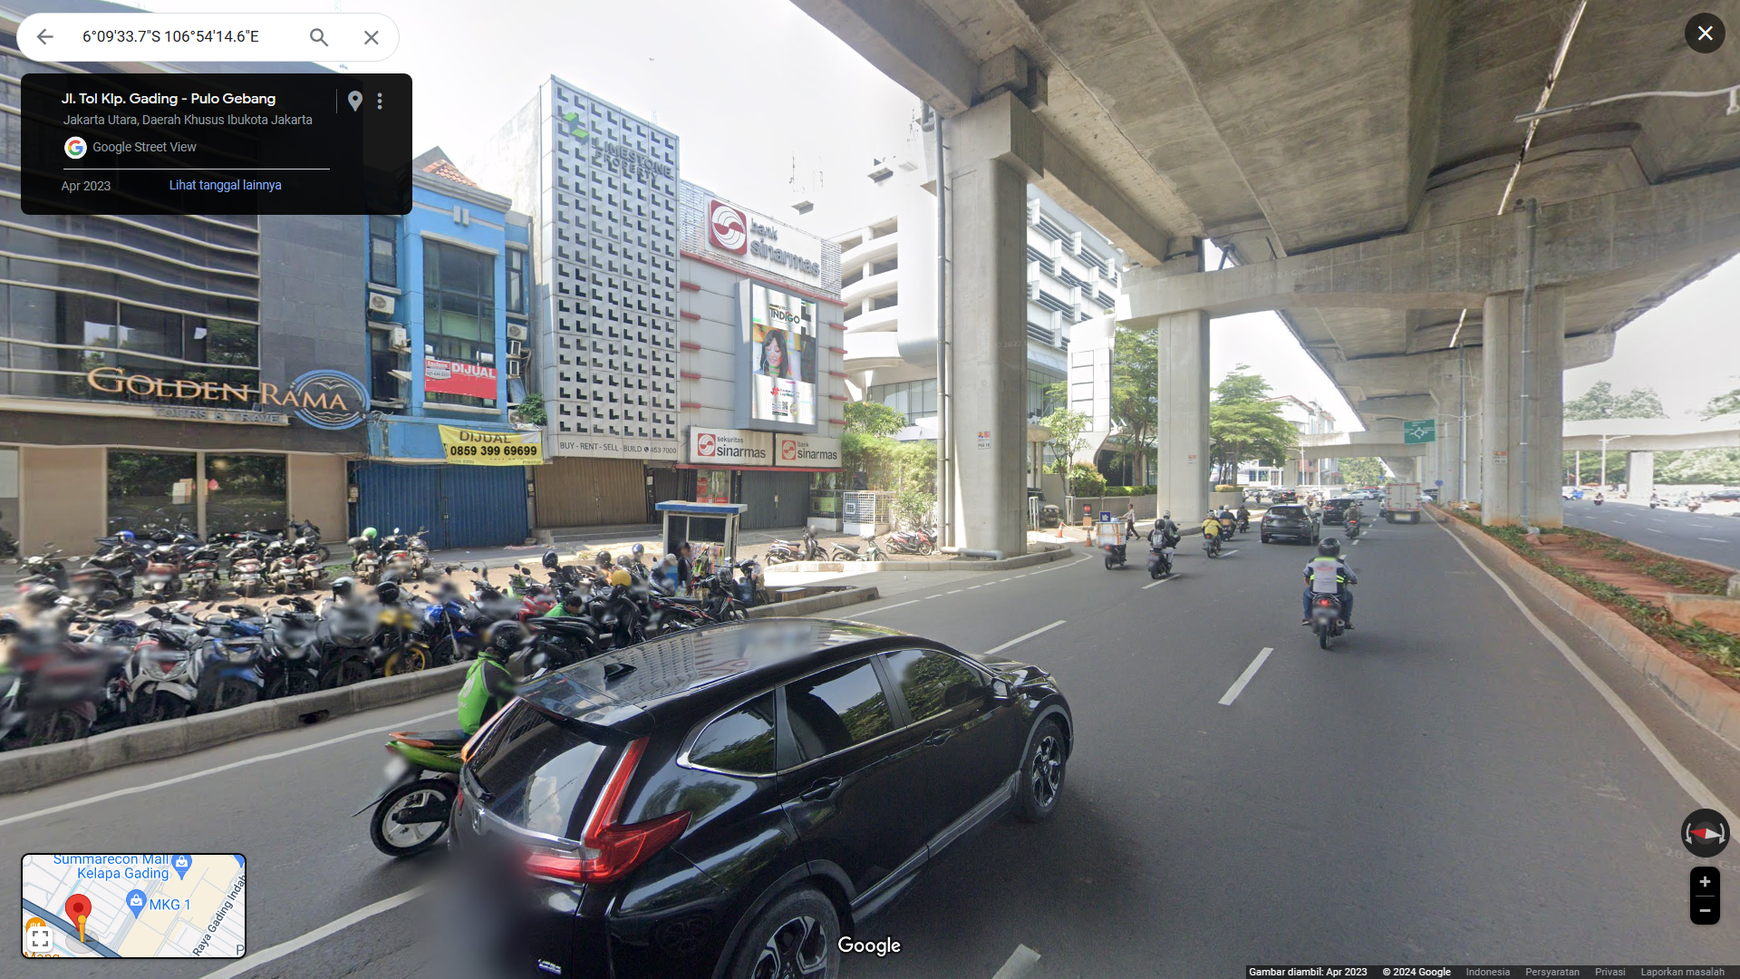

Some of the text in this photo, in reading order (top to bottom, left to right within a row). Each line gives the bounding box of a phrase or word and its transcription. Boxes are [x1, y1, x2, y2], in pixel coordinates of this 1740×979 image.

[750, 217, 778, 241] bank
[750, 237, 820, 278] sinarmas
[451, 362, 496, 379] DIJUAL
[155, 406, 207, 420] TOURS
[213, 411, 223, 421] &
[459, 431, 512, 444] DIJUAL
[450, 446, 537, 456] 0859 399 69699
[560, 442, 575, 450] BUY
[580, 443, 598, 451] RENT
[603, 444, 619, 452] SELL
[716, 444, 766, 459] sinarmas
[797, 448, 837, 460] sinarmas
